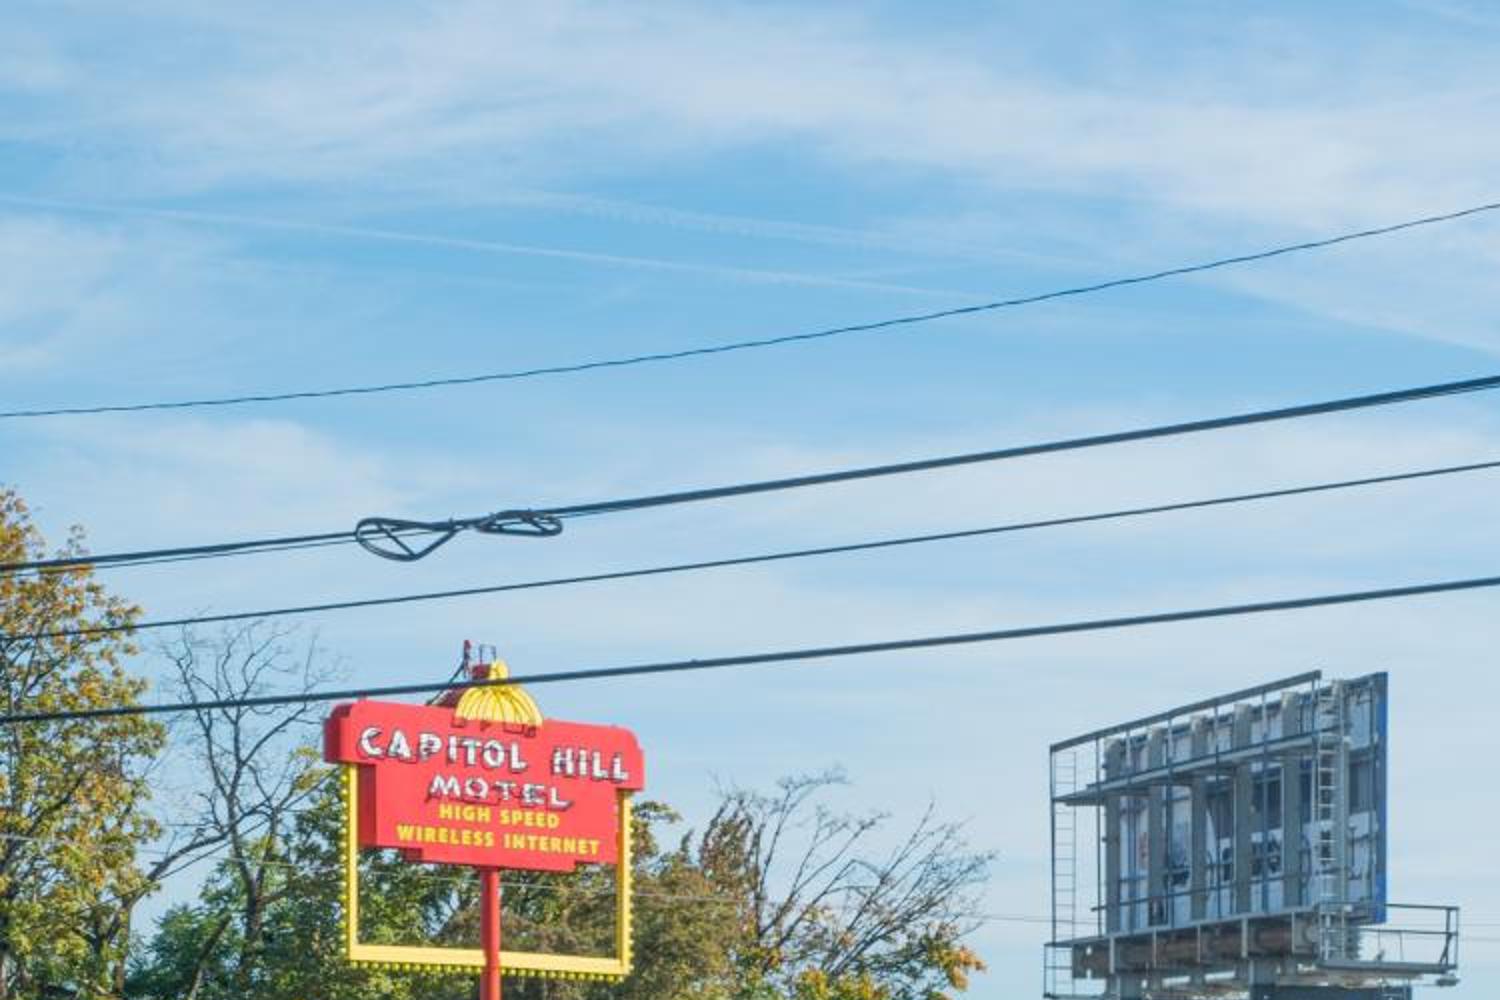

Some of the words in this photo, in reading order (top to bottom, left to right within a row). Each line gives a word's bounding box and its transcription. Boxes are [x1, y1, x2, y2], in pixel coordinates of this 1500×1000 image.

[360, 727, 529, 771] CAPITOL
[552, 747, 629, 783] HILL
[429, 774, 573, 811] MOTEL
[438, 803, 491, 822] HIGH
[500, 809, 560, 829] SPEED
[397, 824, 494, 848] WIRELESS
[504, 834, 600, 855] INTERNET
